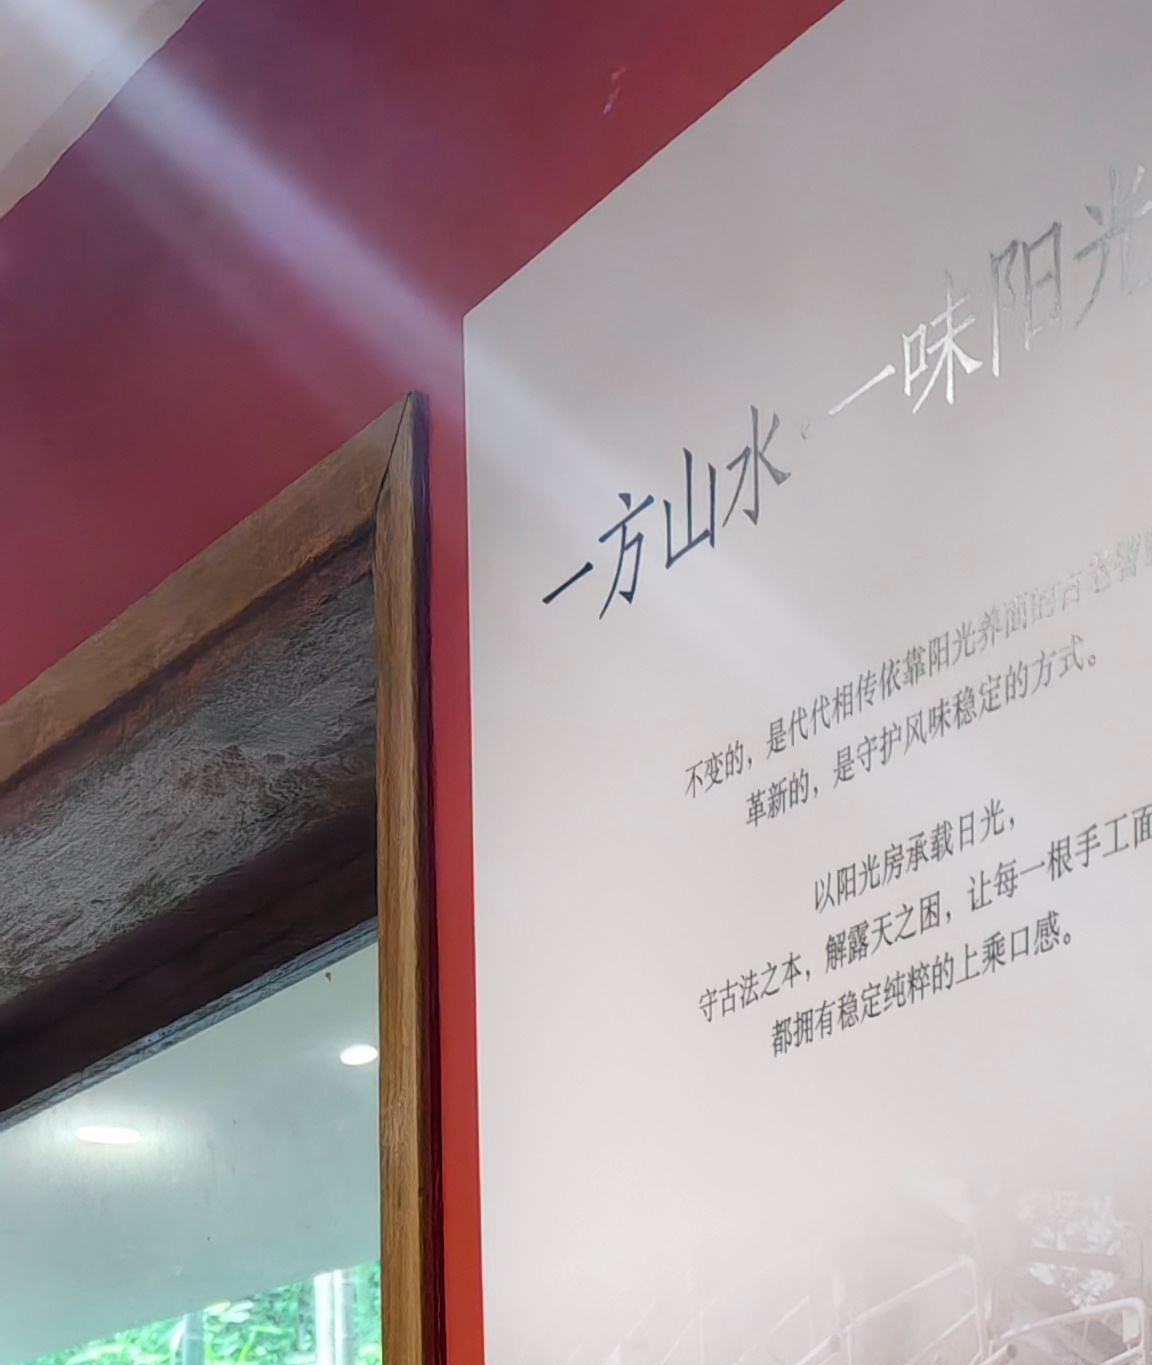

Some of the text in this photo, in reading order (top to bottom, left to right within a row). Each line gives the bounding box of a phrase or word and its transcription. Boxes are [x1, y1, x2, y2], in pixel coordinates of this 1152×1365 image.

[745, 632, 1098, 829] 革新的，是守护风味稳定的方式。
[813, 797, 1016, 914] 以阳光房承载日光，
[770, 910, 1072, 1057] 都拥有稳定纯粹的上乘口感。
